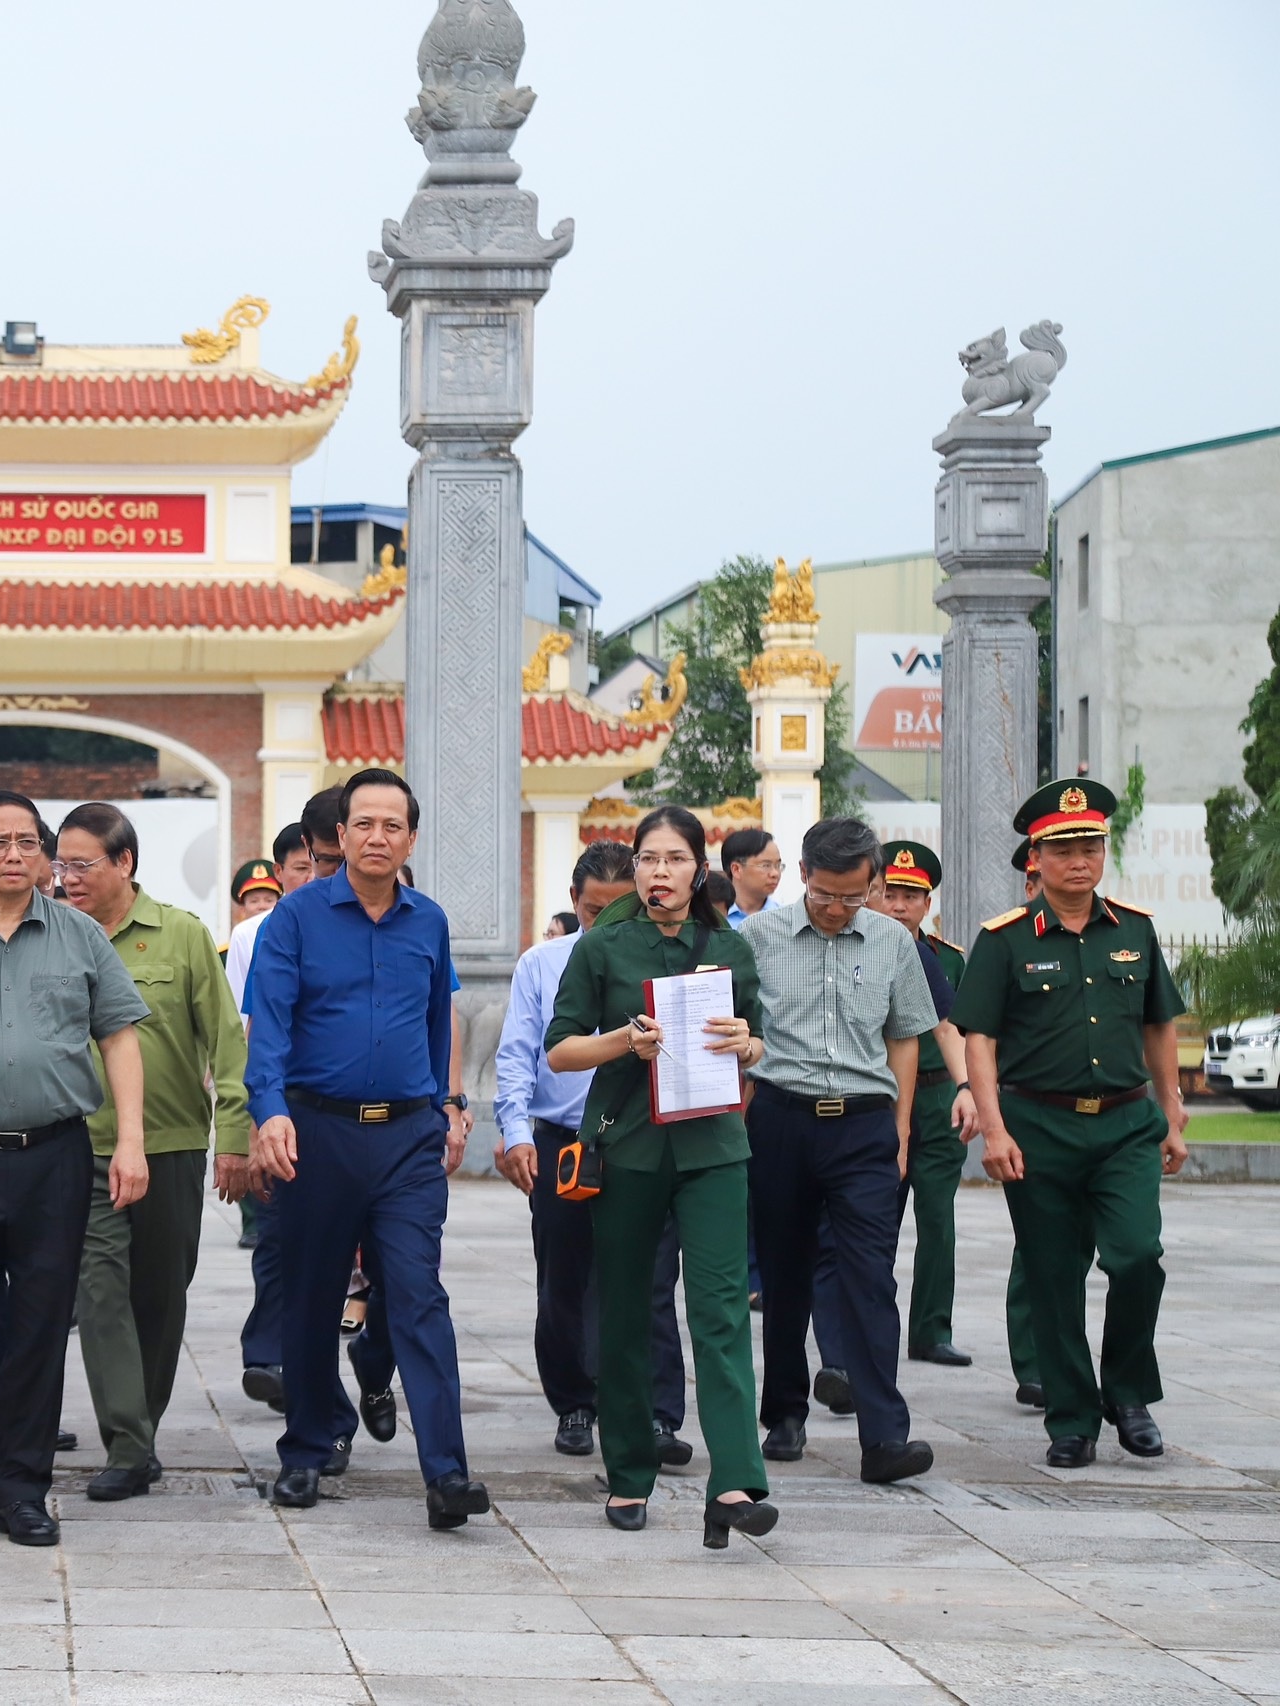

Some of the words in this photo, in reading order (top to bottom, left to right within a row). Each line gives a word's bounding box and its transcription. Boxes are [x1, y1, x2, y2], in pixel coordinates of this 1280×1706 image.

[21, 495, 50, 519] SỬ
[54, 494, 116, 521] QUỐC
[121, 501, 159, 520] GIA
[46, 528, 85, 550] ĐẠI
[93, 524, 136, 550] ĐỘI
[142, 528, 183, 546] 915
